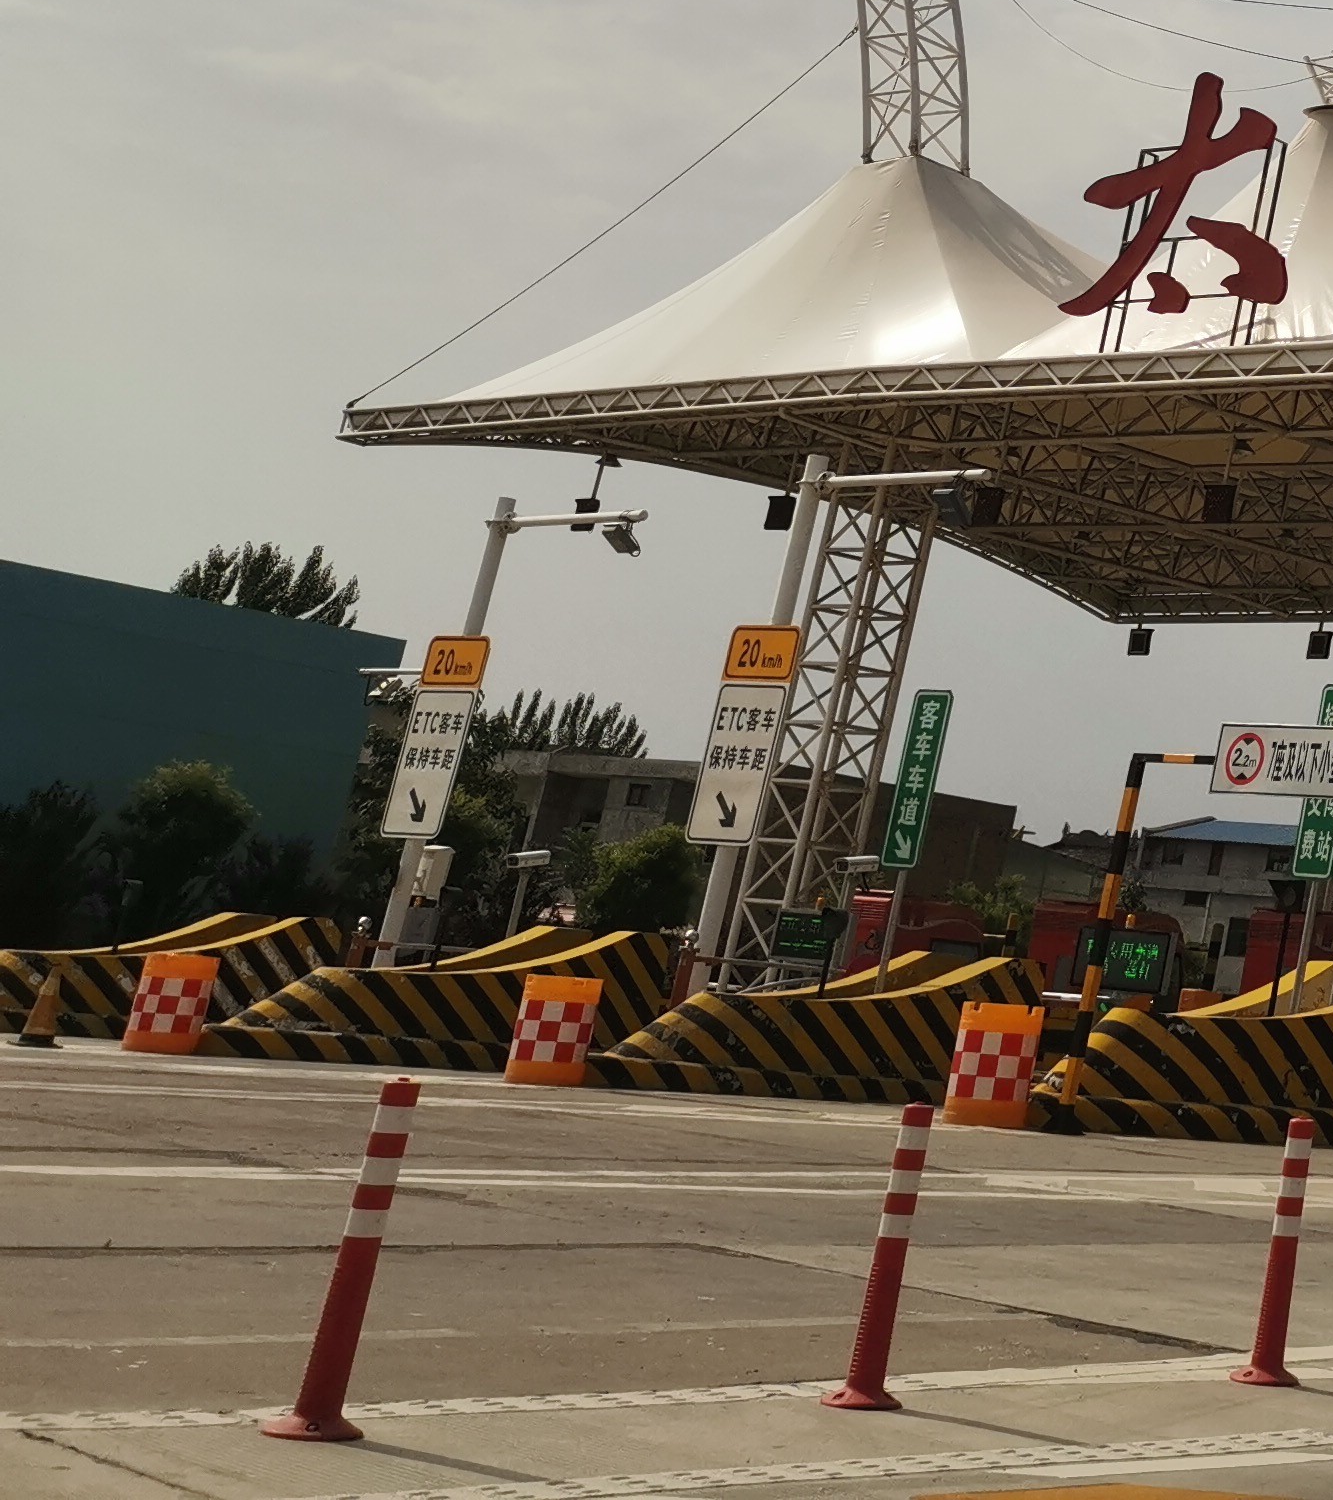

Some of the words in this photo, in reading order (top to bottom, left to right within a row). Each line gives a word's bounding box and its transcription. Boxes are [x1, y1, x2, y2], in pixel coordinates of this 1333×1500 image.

[432, 648, 455, 676] 20
[737, 638, 761, 668] 20
[761, 652, 783, 669] km/h
[411, 711, 465, 736] ETC客车
[716, 706, 777, 733] ETC客车
[403, 746, 456, 771] 保持车距
[708, 744, 769, 771] 保持车距
[897, 699, 941, 826] 客车车道
